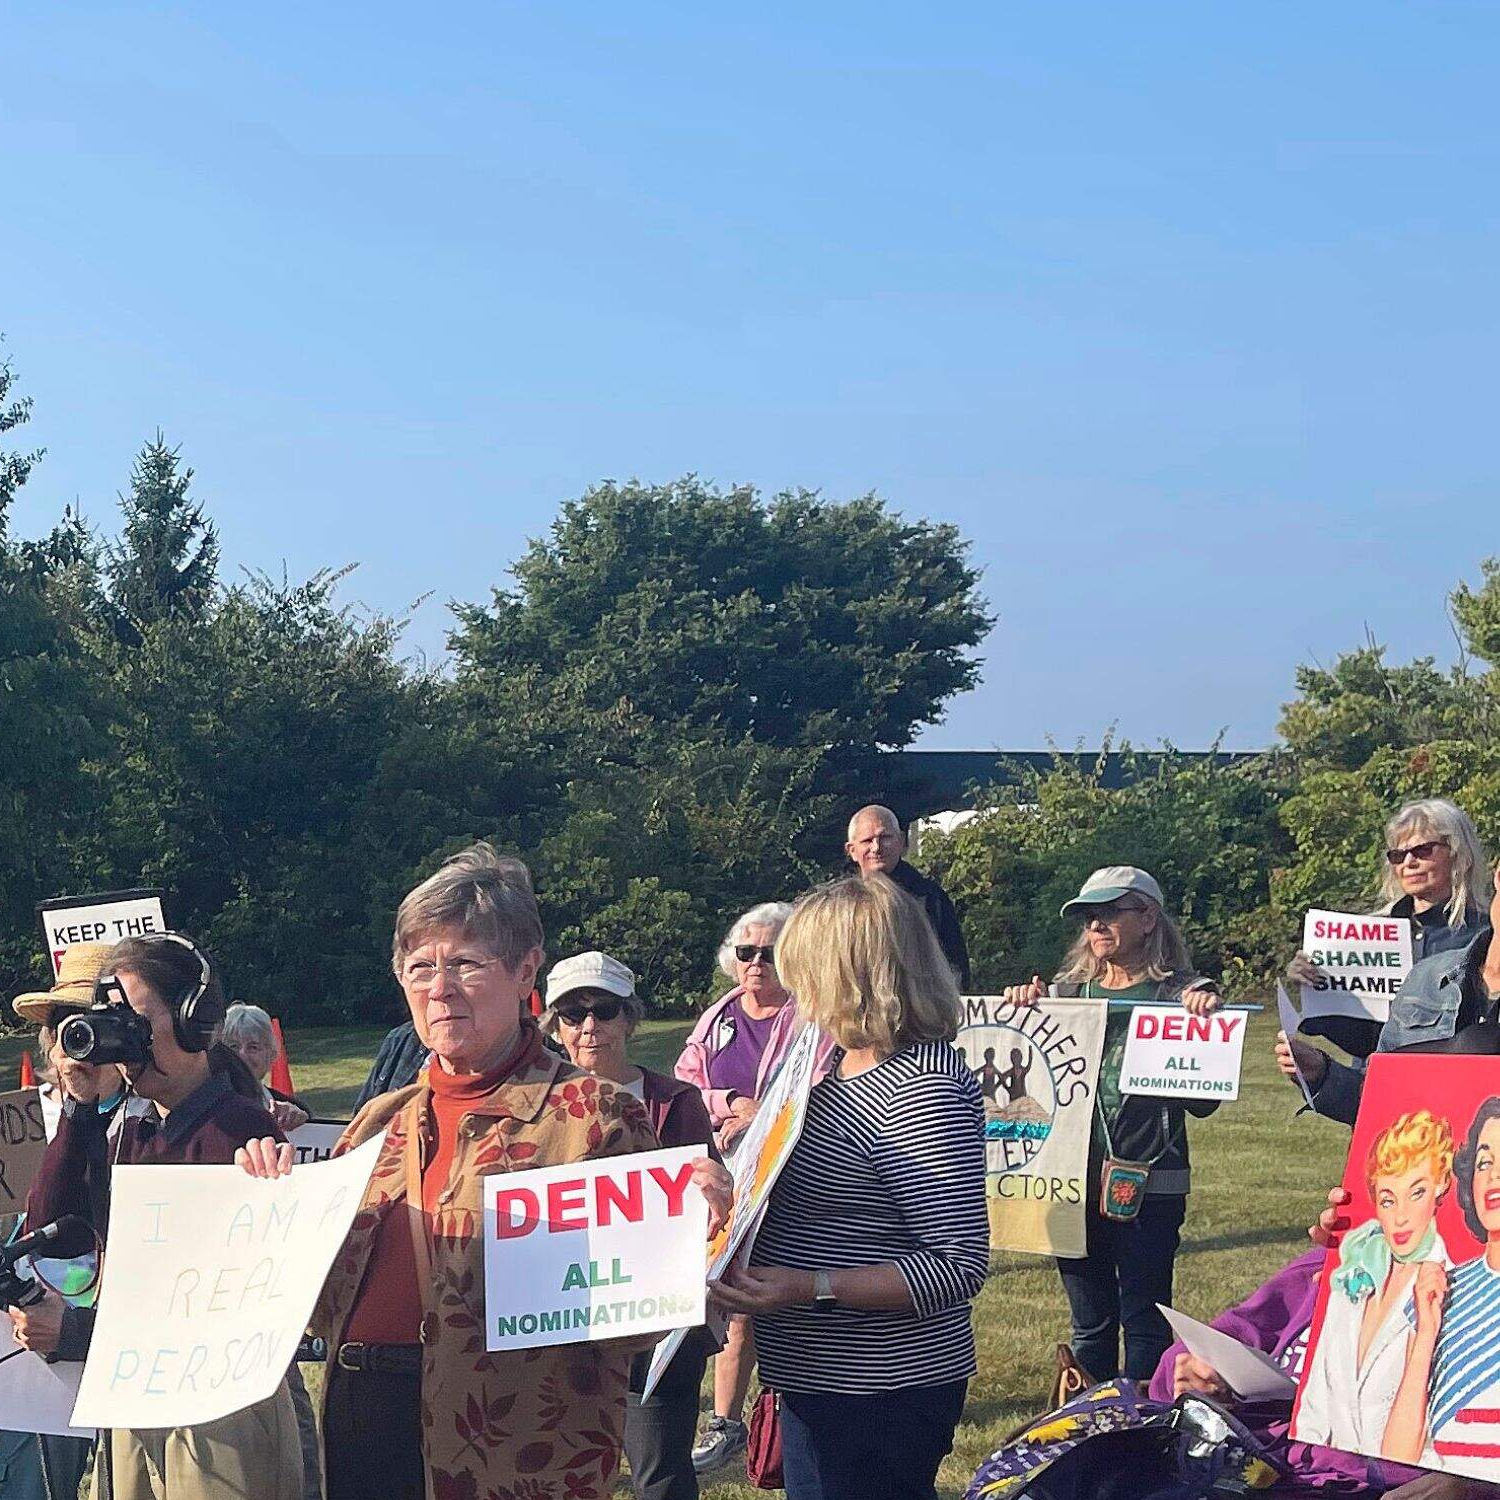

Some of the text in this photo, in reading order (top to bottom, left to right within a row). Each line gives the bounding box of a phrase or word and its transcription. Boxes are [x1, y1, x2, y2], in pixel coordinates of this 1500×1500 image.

[53, 916, 155, 945] KEEP THE
[1314, 920, 1399, 942] SHAME
[1309, 950, 1402, 968] SHAME
[1313, 975, 1402, 995] SHAME
[1135, 1014, 1242, 1043] DENY
[1164, 1056, 1202, 1071] ALL
[1128, 1076, 1234, 1092] NOMINATIONS
[496, 1163, 696, 1240] DENY
[141, 1203, 169, 1242] I
[227, 1199, 299, 1246] AM
[167, 1257, 287, 1317] REAL
[562, 1258, 632, 1291] ALL
[498, 1294, 695, 1337] NOMINATIONS
[109, 1331, 285, 1395] PERSON
